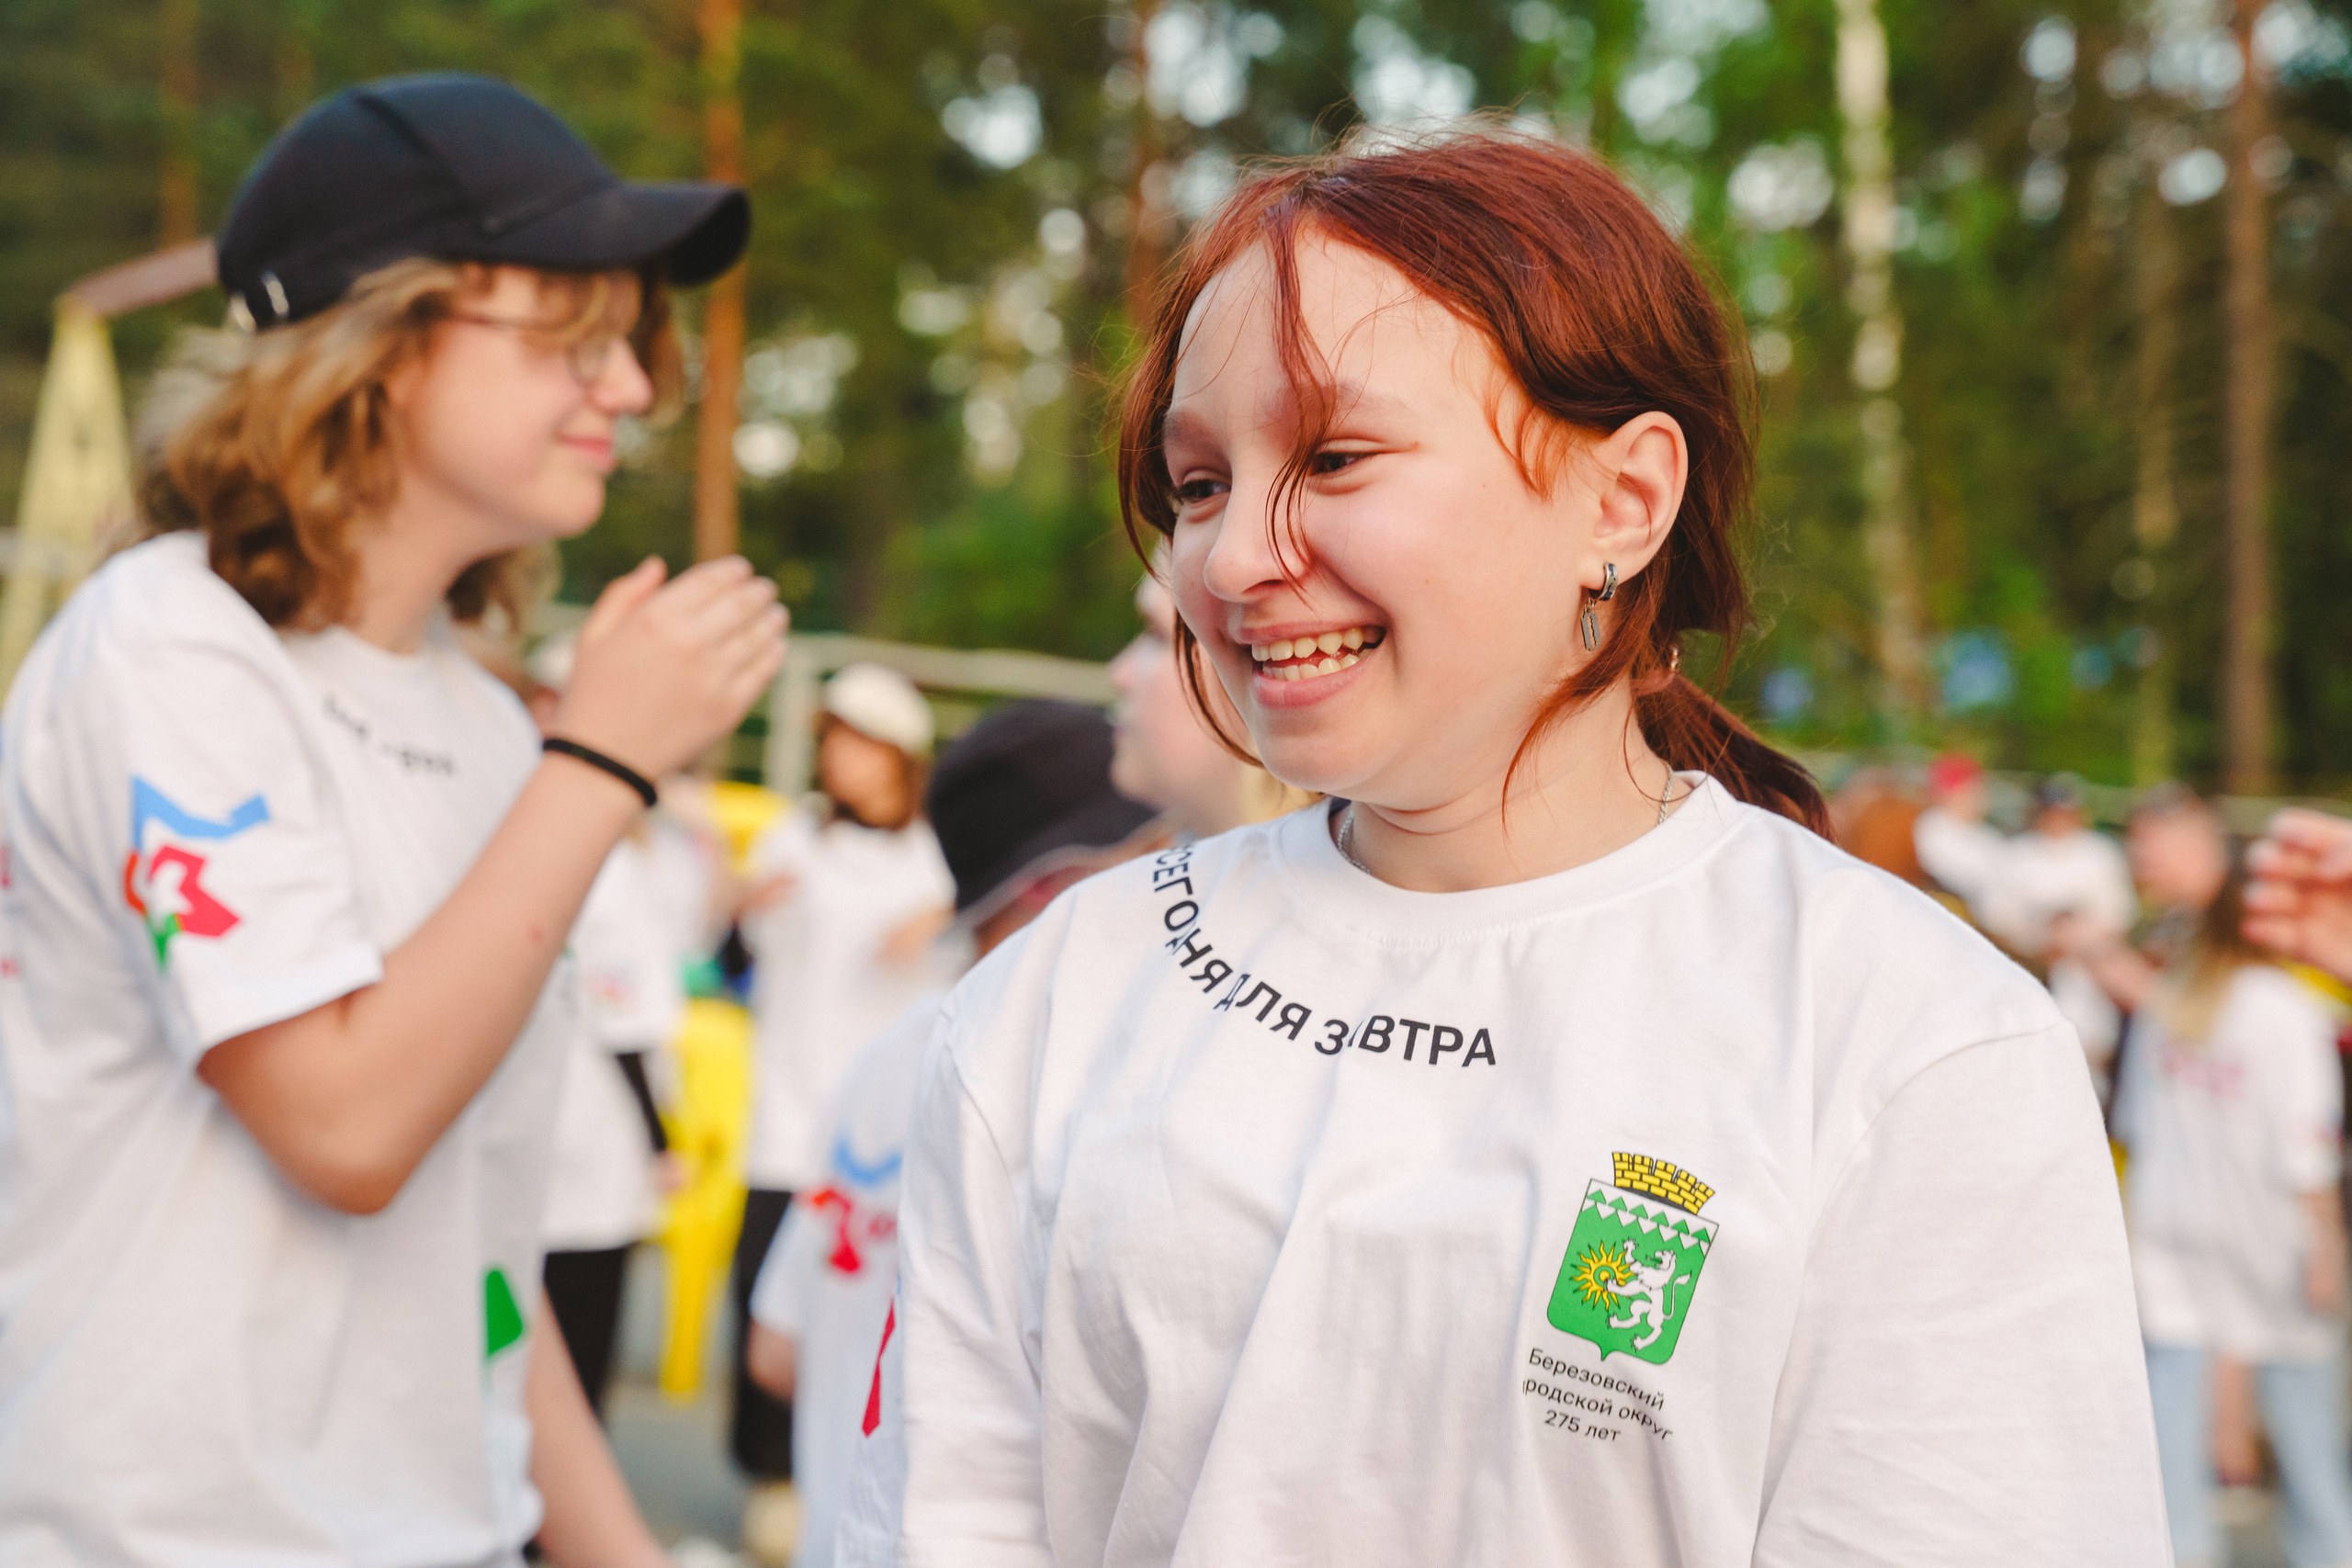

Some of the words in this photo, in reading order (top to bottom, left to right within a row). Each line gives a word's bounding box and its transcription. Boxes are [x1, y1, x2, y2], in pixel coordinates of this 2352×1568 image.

[1314, 1014, 1497, 1068] ЗВТРА
[1528, 1348, 1666, 1412] Березовский
[1521, 1378, 1614, 1416] родской
[1618, 1405, 1674, 1442] округ
[1544, 1409, 1581, 1433] 275
[1584, 1425, 1623, 1443] лет
